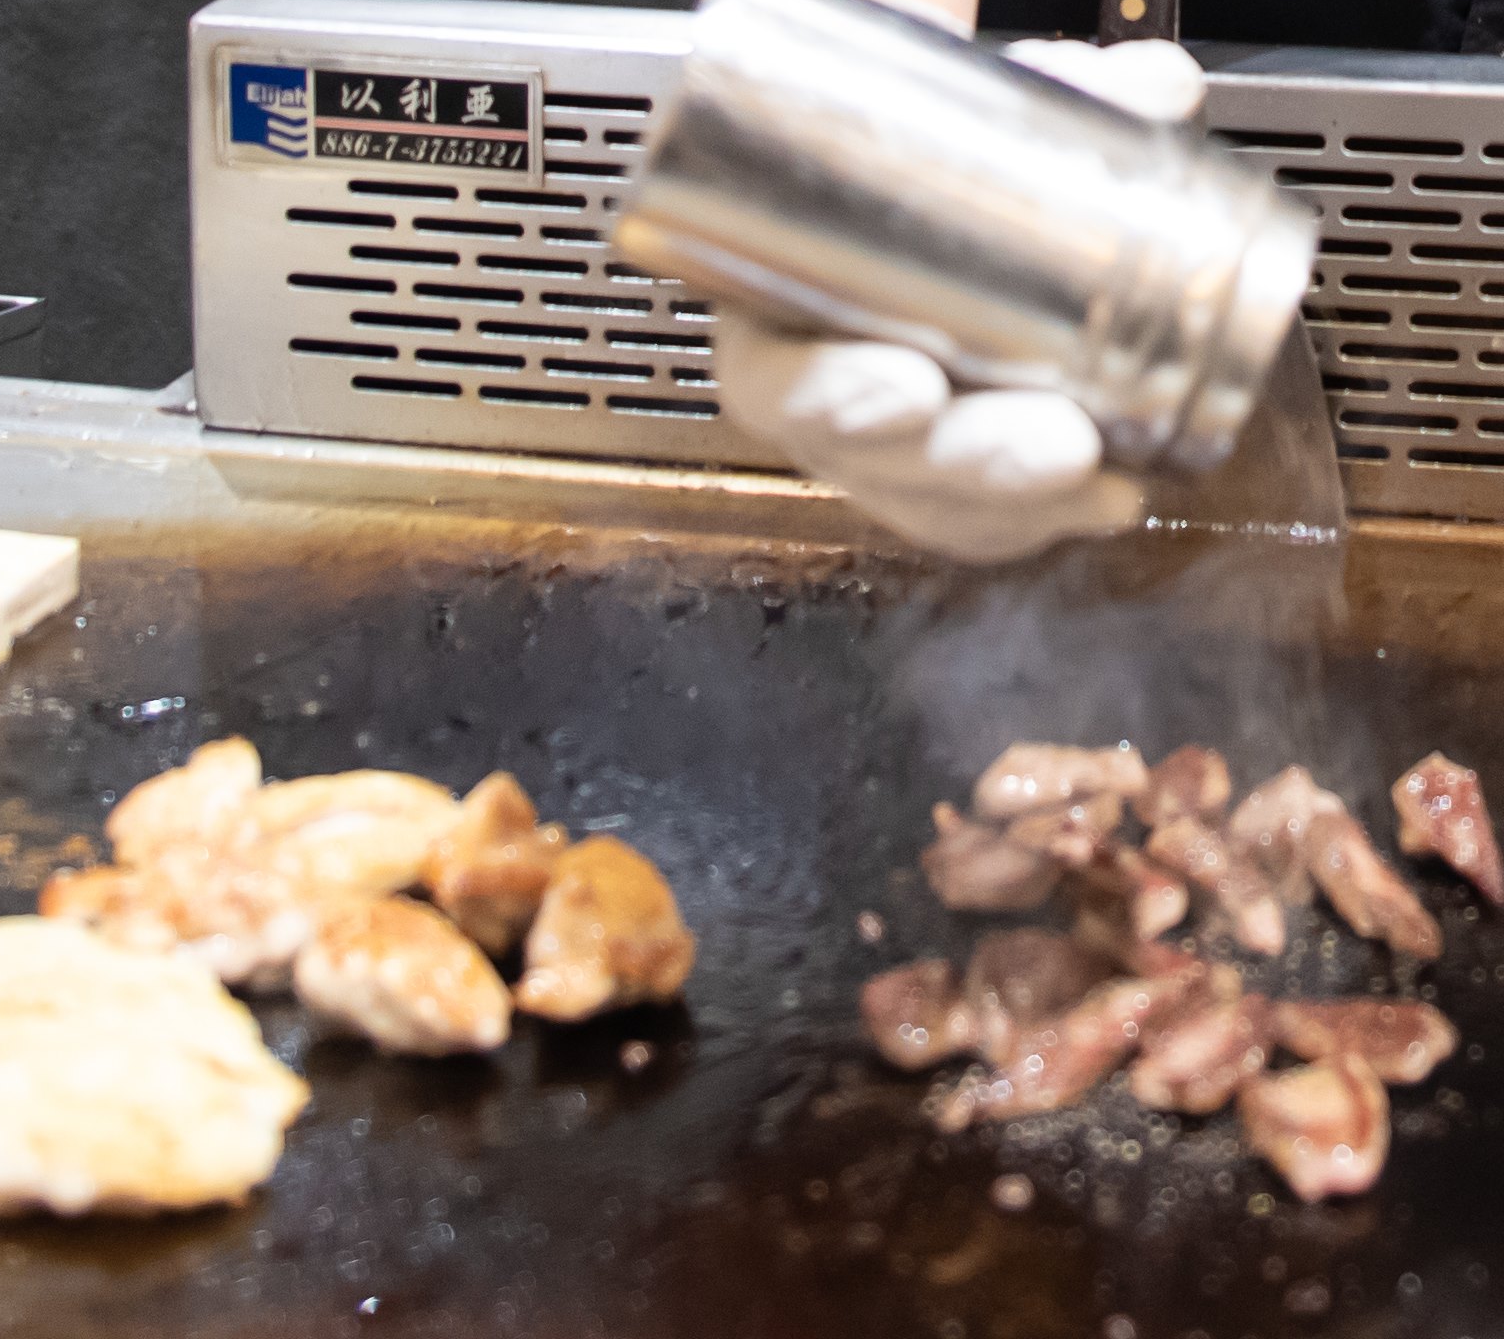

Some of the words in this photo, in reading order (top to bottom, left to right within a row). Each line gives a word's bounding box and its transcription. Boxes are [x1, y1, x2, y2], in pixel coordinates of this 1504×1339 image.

[246, 82, 307, 109] Elijah
[341, 78, 500, 124] 以利亞
[321, 129, 523, 168] 886-7-3755221
